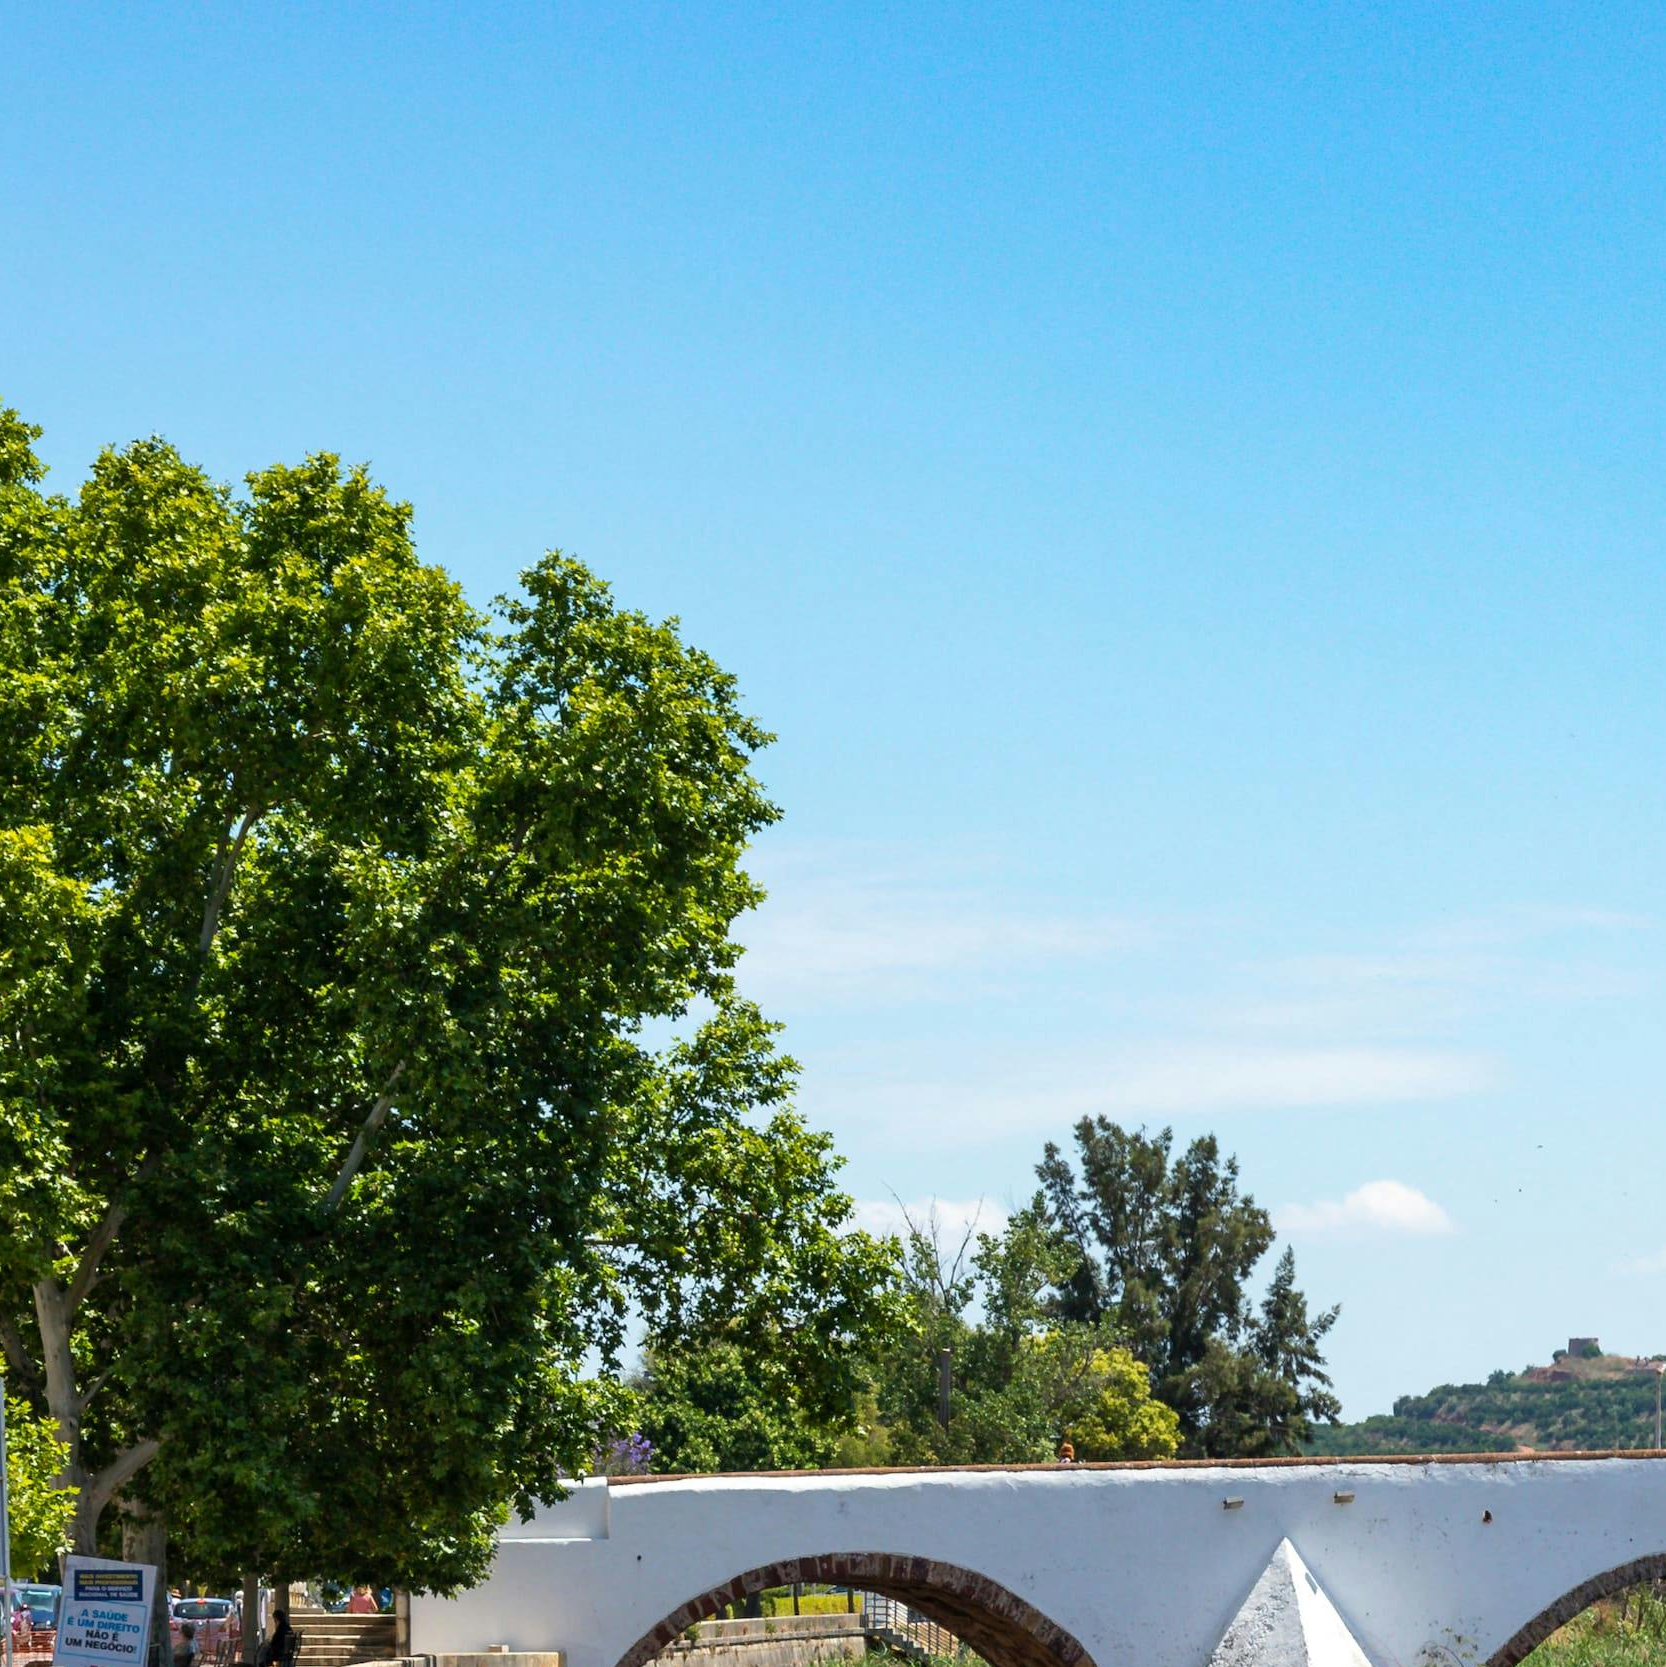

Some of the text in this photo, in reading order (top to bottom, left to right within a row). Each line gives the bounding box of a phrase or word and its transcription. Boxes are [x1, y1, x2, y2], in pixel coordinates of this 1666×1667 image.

[81, 1608, 129, 1622] A SAÚDE
[67, 1616, 140, 1634] É UM DIREITO
[85, 1628, 119, 1641] NÃO É
[65, 1637, 138, 1654] UM NEGÓCIO!
